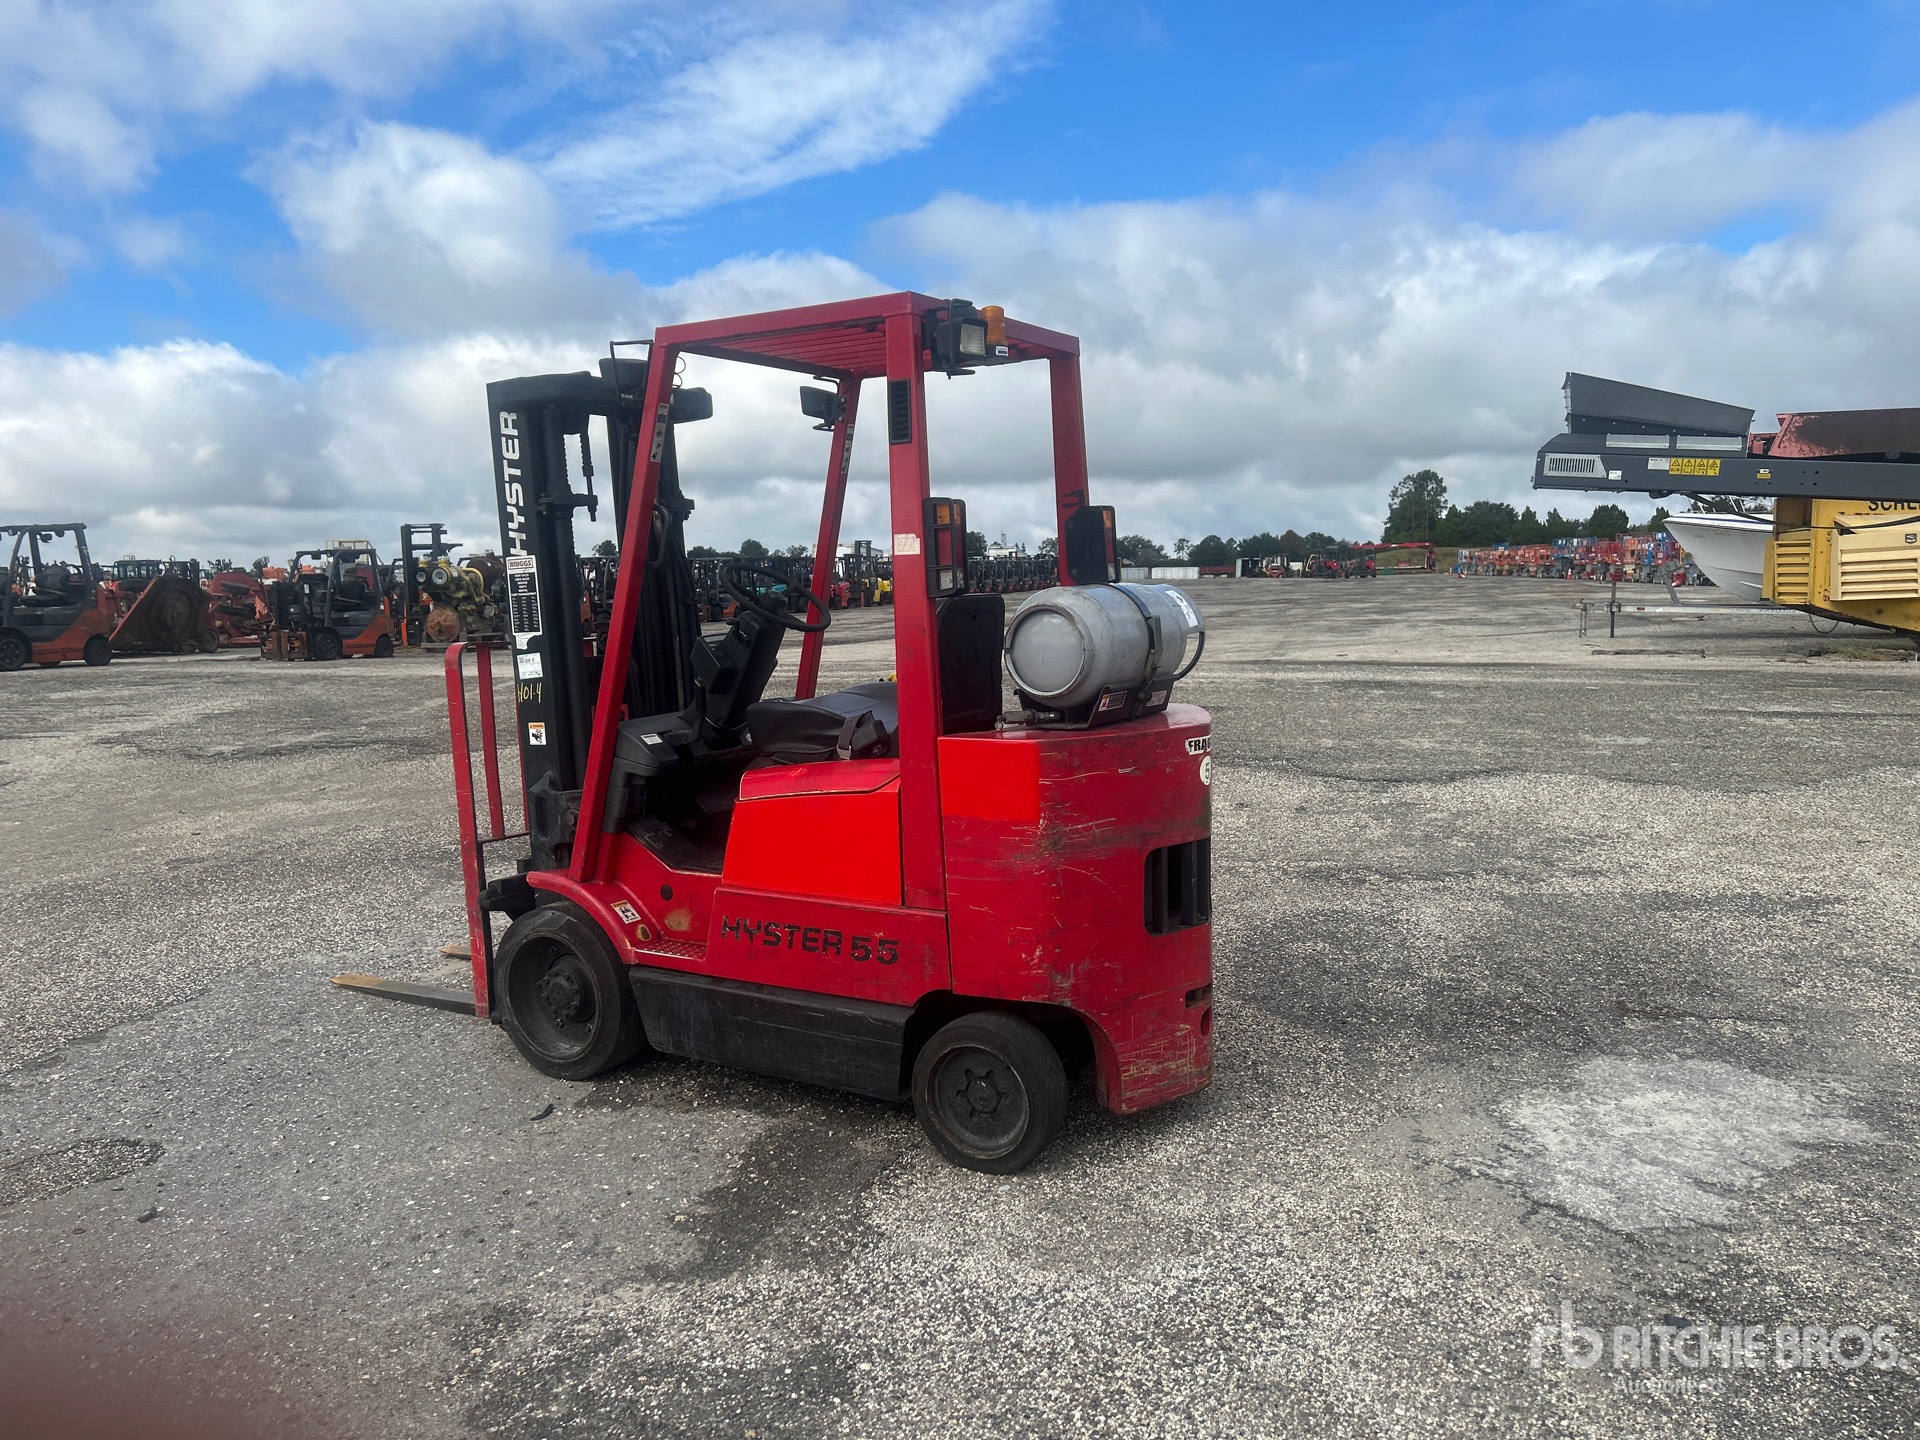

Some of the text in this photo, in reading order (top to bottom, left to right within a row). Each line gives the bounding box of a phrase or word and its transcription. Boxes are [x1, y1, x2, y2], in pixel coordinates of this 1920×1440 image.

[500, 411, 527, 556] HYSTER
[721, 915, 899, 965] HYSTER 55
